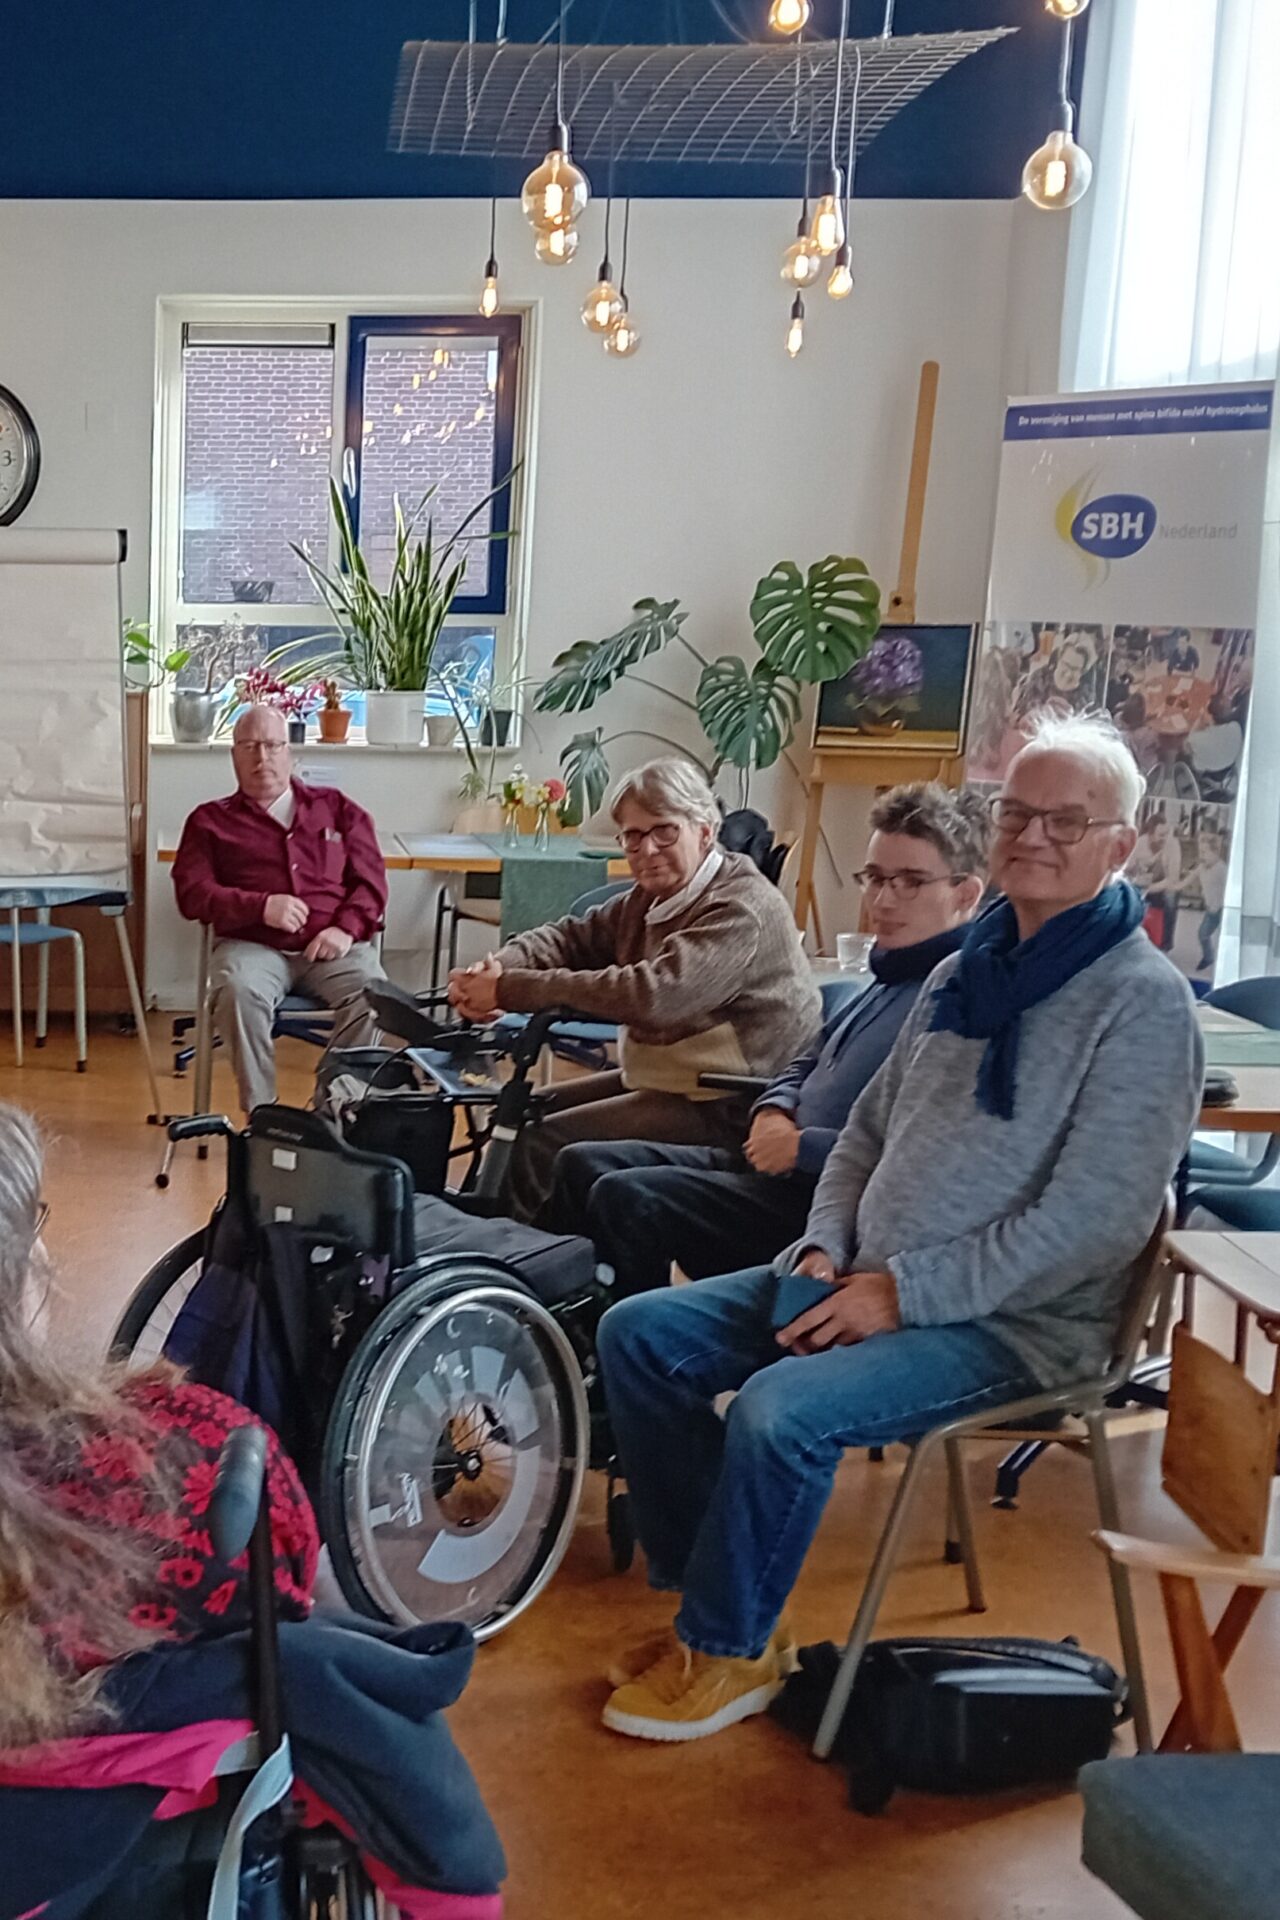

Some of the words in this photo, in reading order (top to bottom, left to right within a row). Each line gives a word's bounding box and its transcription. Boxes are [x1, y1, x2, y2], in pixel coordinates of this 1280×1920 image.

[2, 449, 12, 467] 3
[1081, 511, 1145, 540] SBH
[1159, 524, 1238, 540] Nederland
